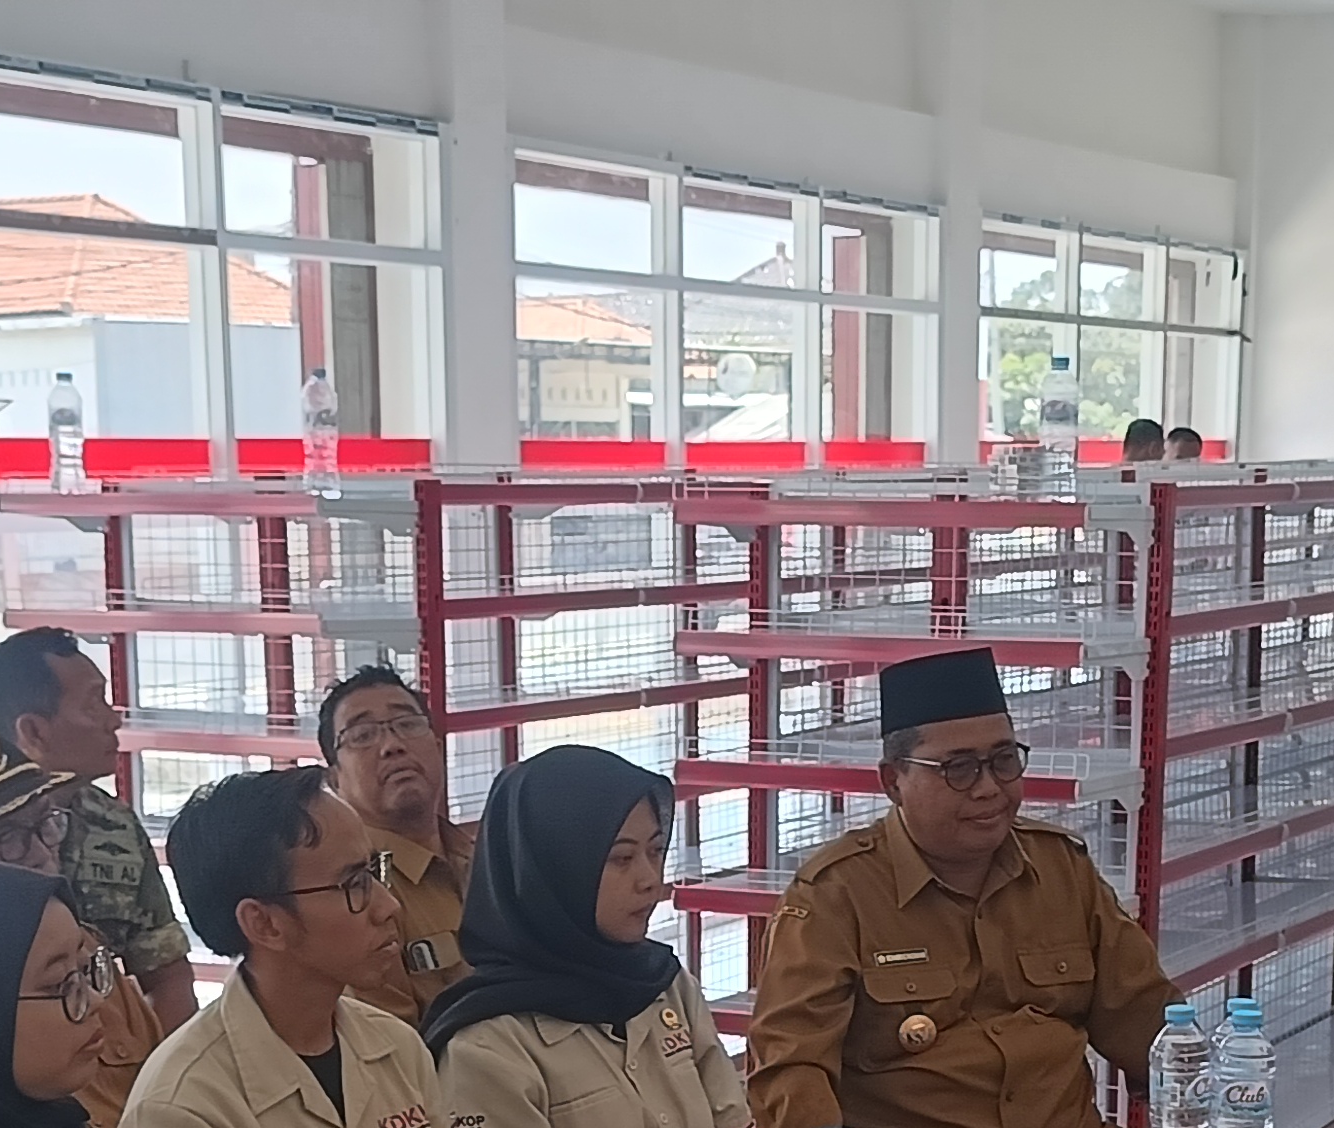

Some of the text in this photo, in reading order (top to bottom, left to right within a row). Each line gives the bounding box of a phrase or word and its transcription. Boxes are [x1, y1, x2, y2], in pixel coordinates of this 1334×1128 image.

[91, 862, 114, 881] TNI
[1226, 1085, 1265, 1104] Club
[456, 1115, 485, 1128] KOP
